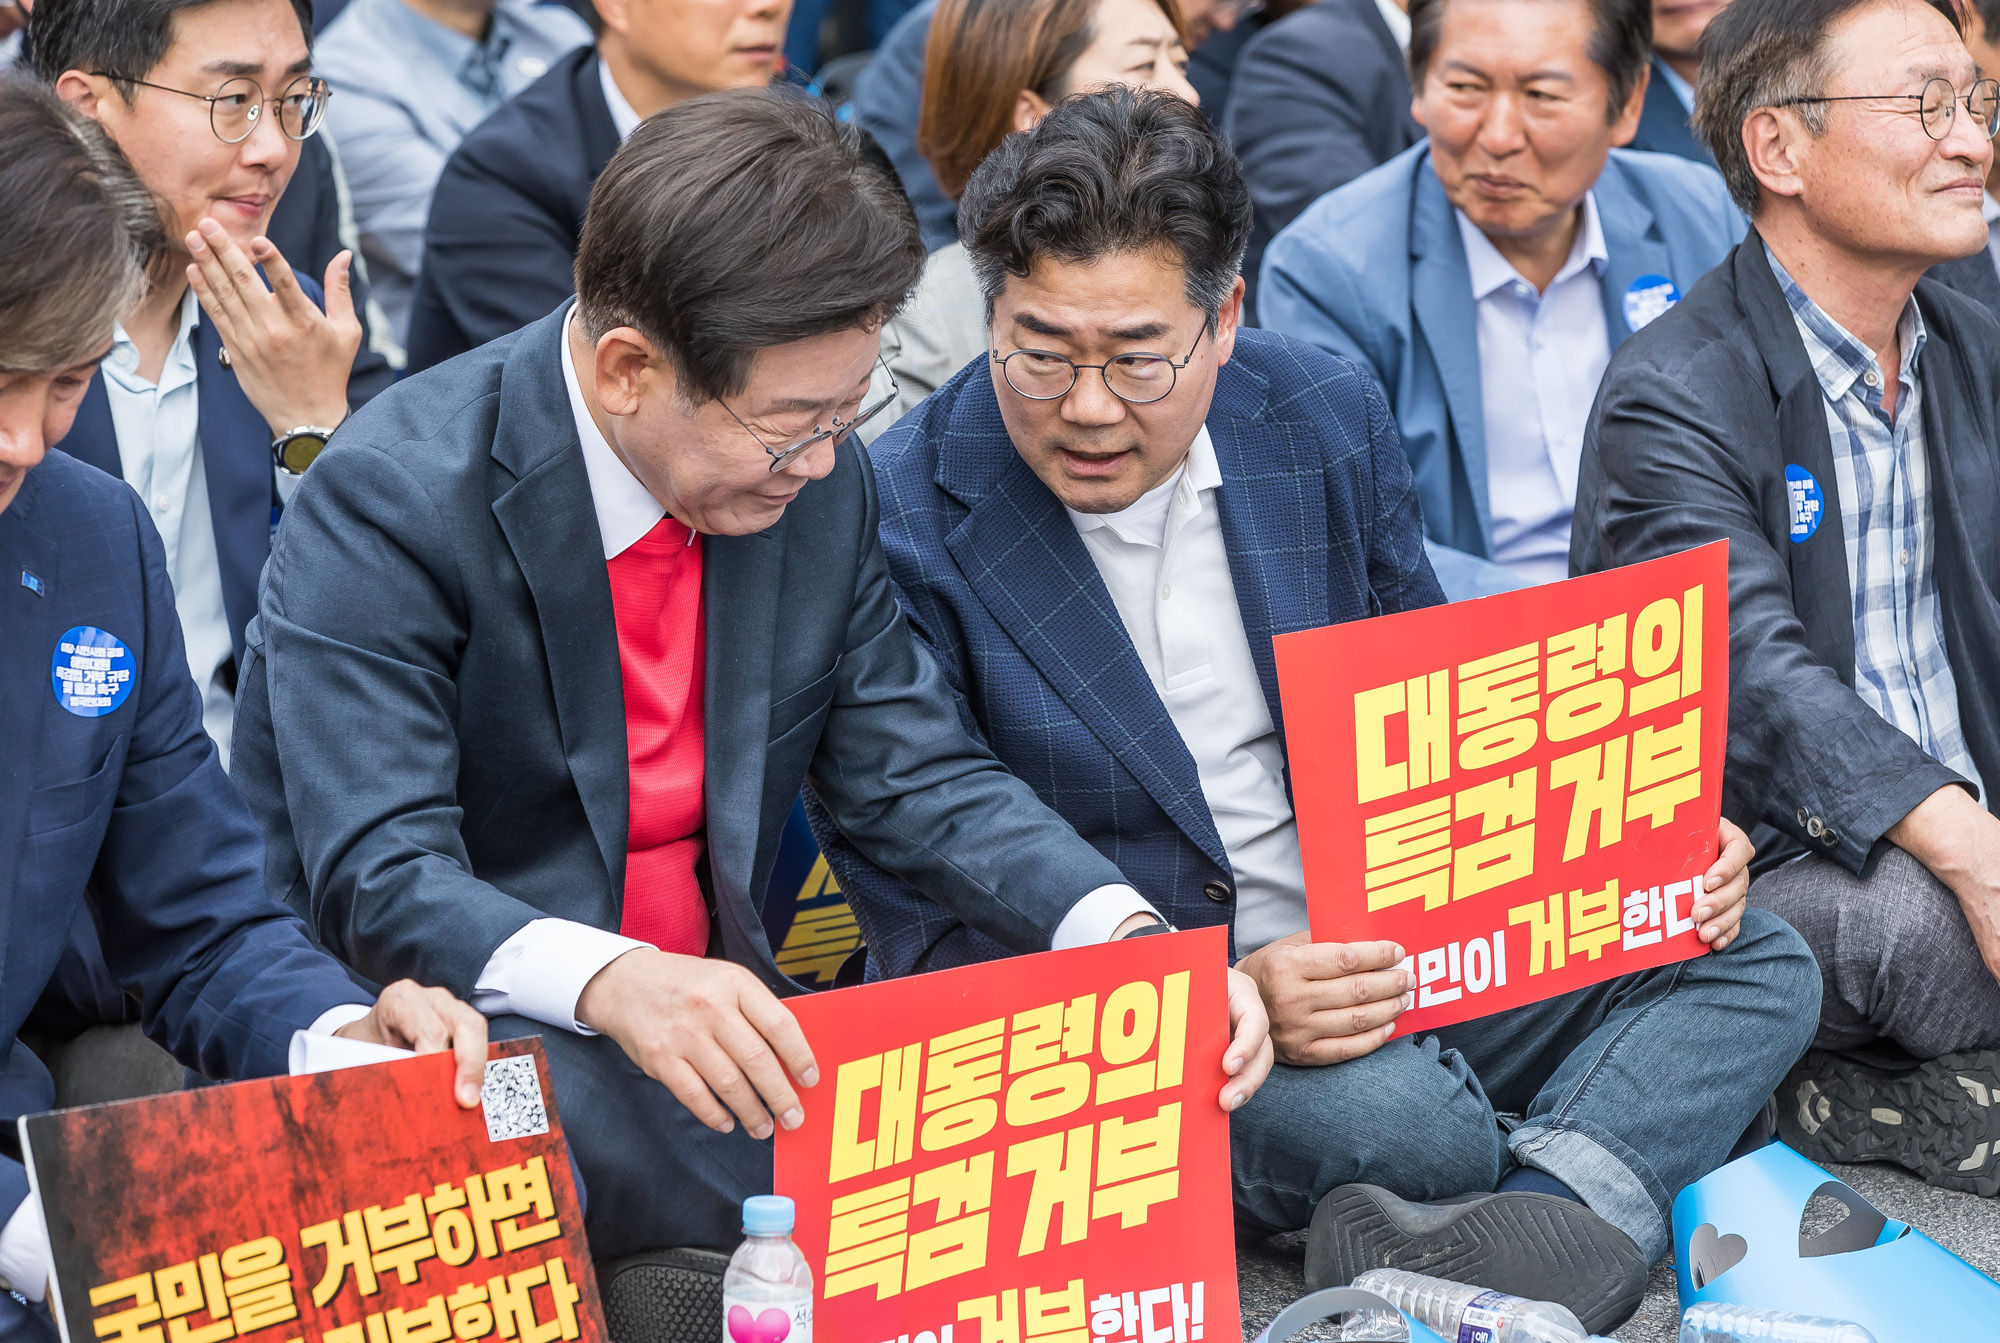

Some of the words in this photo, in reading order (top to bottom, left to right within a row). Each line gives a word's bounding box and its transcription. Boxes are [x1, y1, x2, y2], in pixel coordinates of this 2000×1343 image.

[1354, 583, 1704, 805] 대통령의
[1365, 766, 1538, 913] 특검
[1549, 706, 1702, 864] 거부
[828, 970, 1191, 1185] 대통령의
[88, 1235, 297, 1343] 국민을
[299, 1155, 561, 1308] 거부하면
[823, 1150, 995, 1301] 특검
[1006, 1101, 1182, 1258] 거부
